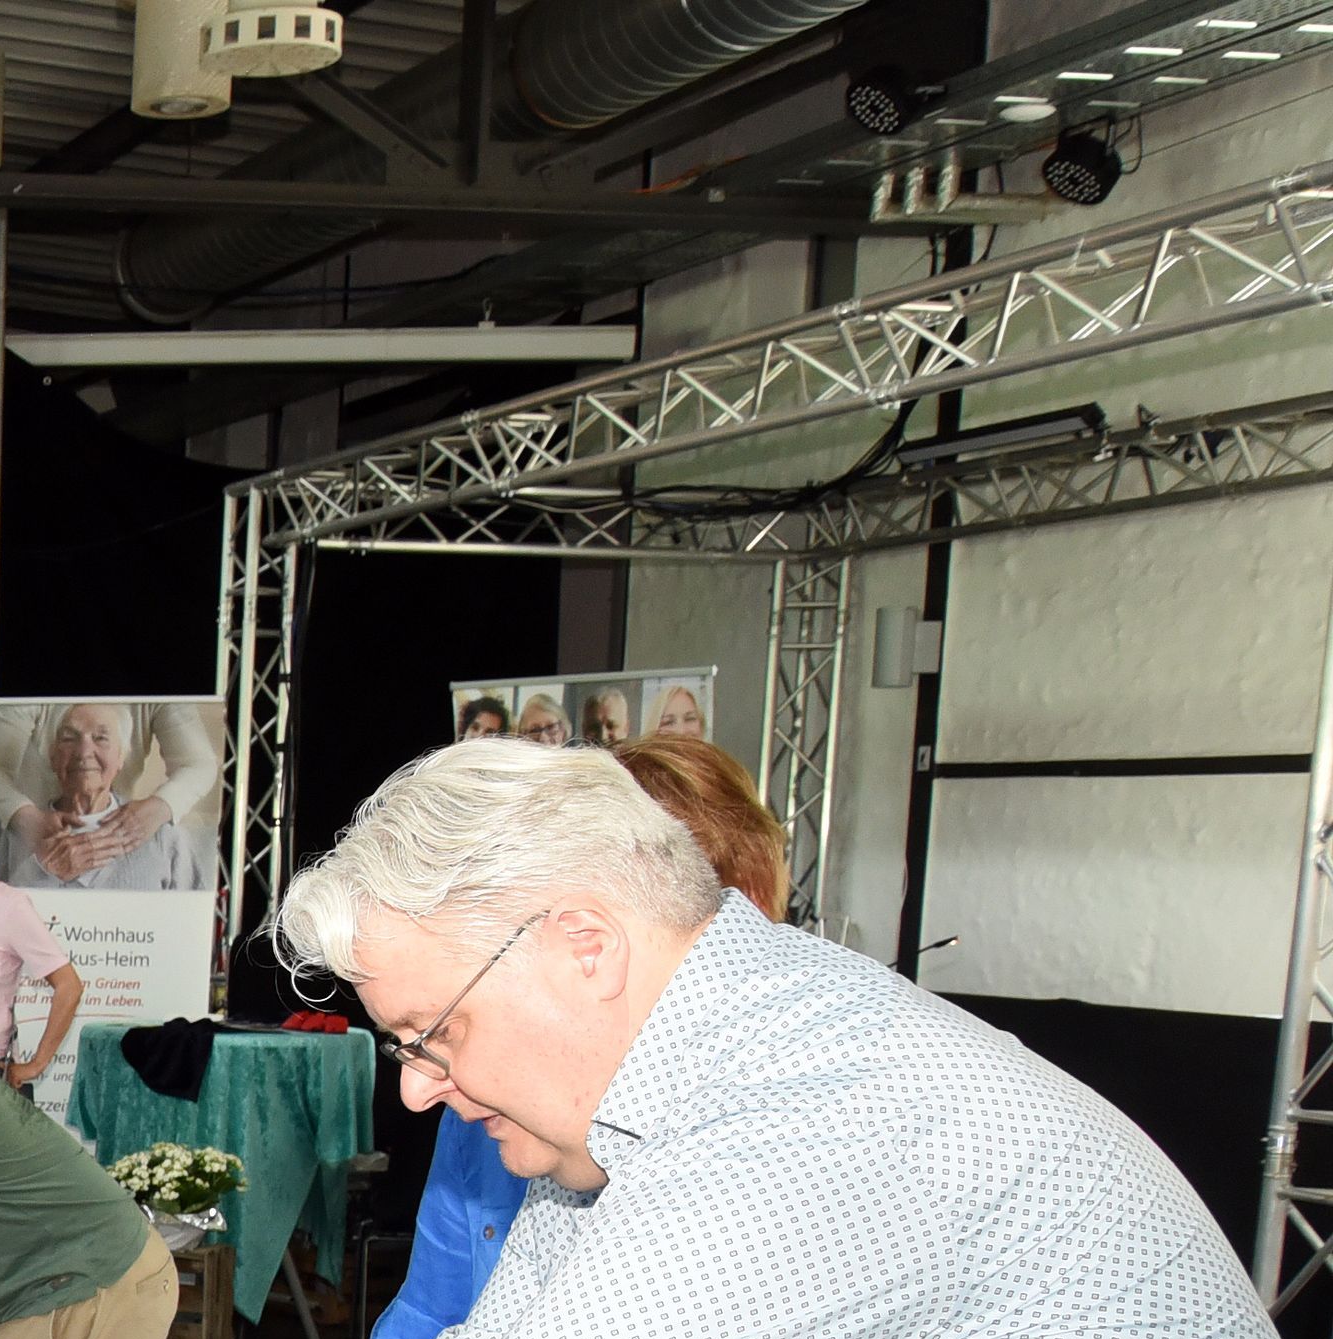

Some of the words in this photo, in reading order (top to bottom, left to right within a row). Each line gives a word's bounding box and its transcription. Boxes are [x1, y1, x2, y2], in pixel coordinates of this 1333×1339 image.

[56, 926, 155, 943] -Wohnhaus
[66, 950, 150, 967] kus-Heim
[95, 977, 141, 990] Grünen
[85, 995, 102, 1005] im
[105, 995, 144, 1007] Leben.
